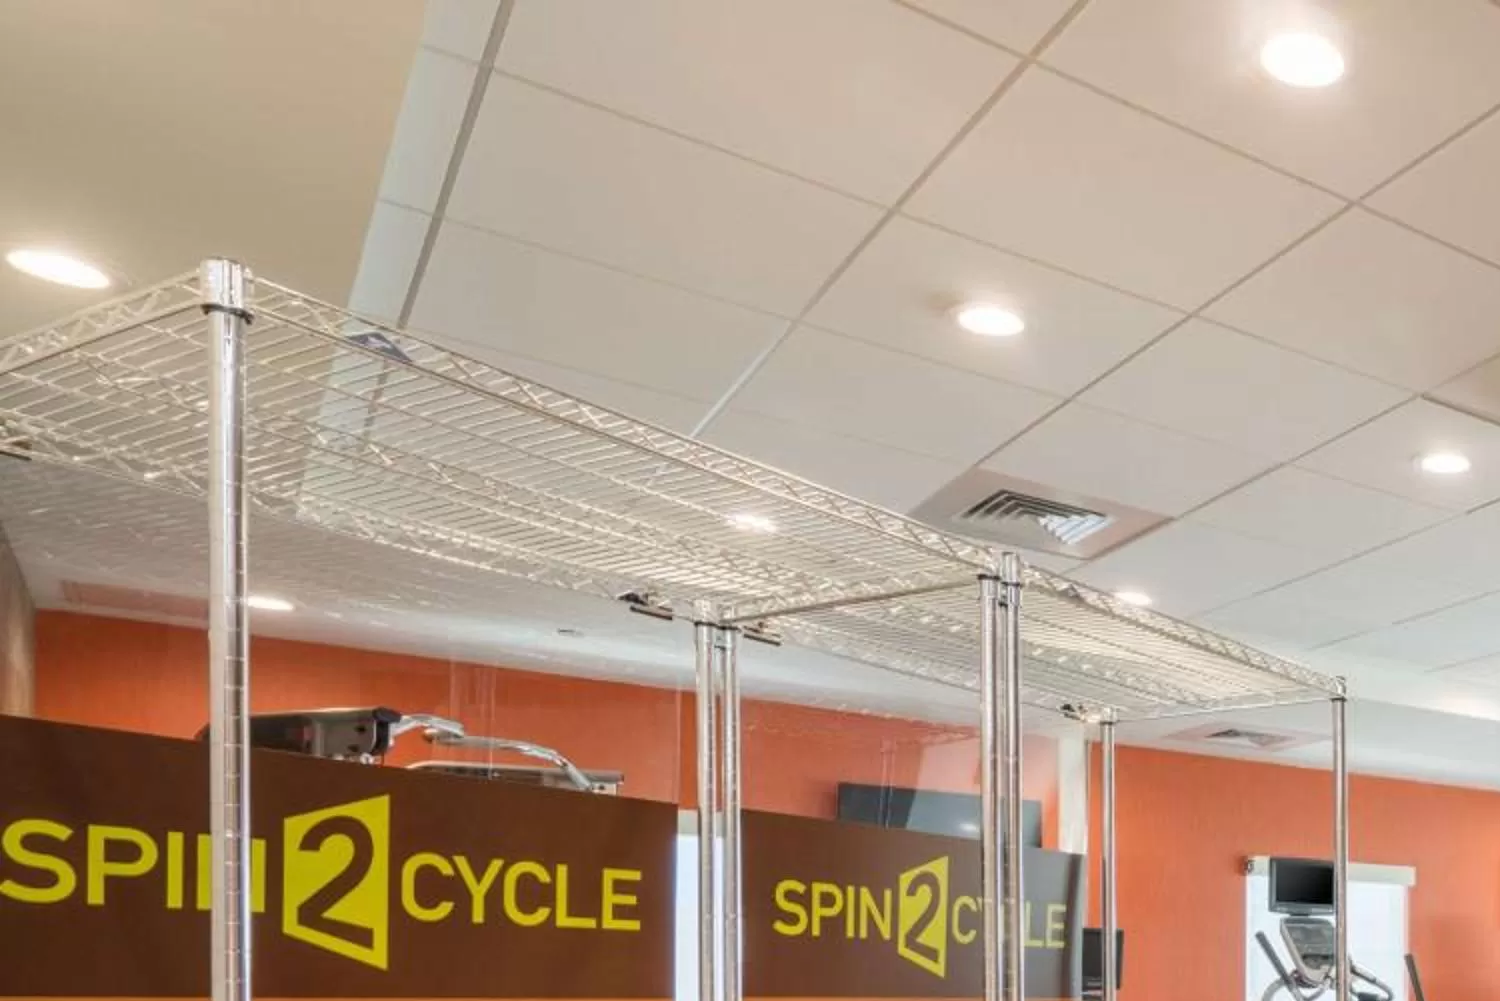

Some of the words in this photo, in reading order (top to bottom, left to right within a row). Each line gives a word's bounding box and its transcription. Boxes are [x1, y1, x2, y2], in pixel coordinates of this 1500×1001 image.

[296, 814, 375, 950] 2
[401, 853, 641, 931] CYCLE
[773, 878, 892, 941] SPIN
[903, 870, 942, 966] 2
[952, 895, 1067, 949] CLE
